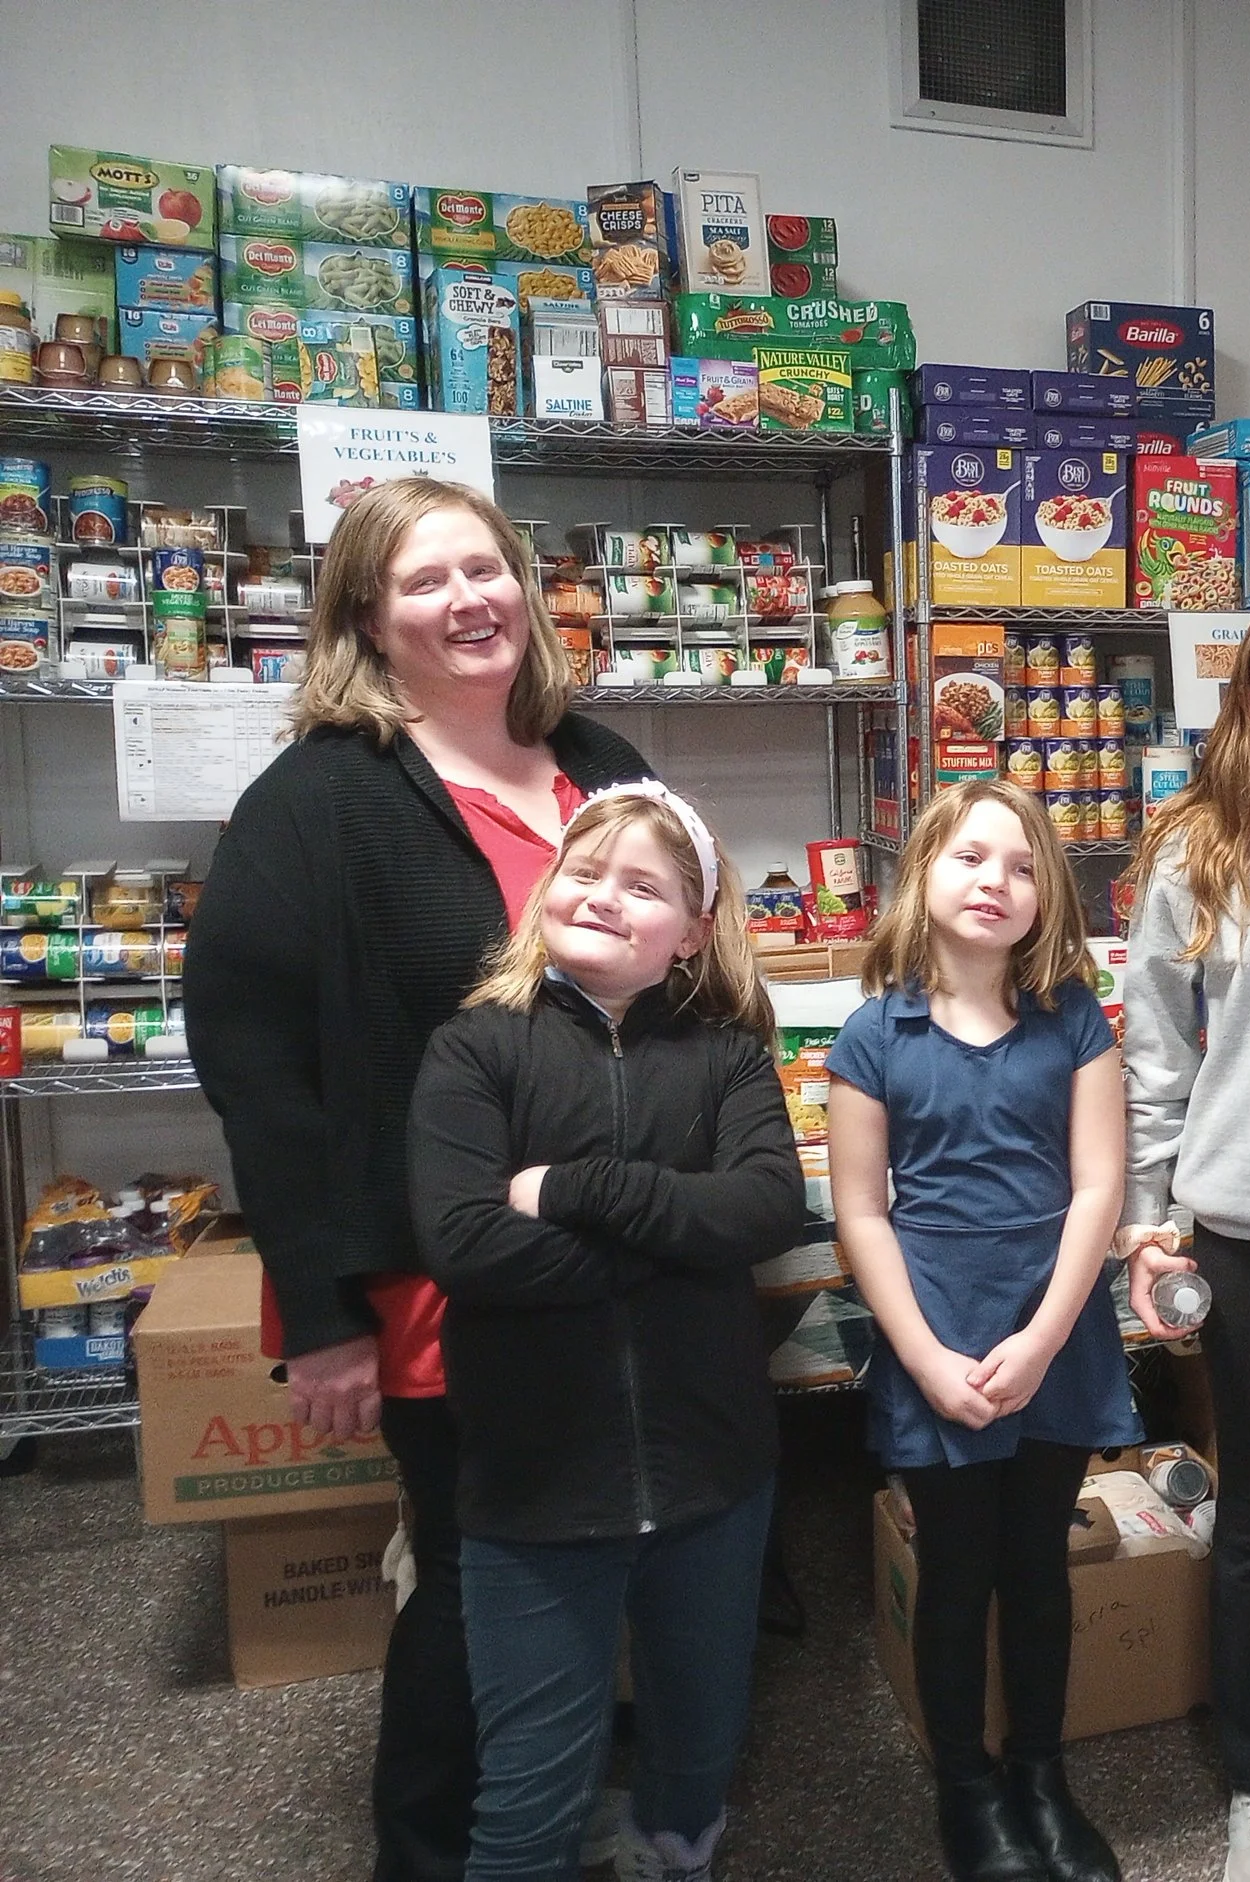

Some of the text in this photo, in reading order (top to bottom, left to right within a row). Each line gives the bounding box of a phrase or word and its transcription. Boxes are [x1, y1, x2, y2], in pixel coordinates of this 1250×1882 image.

[394, 188, 403, 200] 8
[441, 203, 483, 216] Del Monte
[701, 193, 747, 215] PITA
[578, 205, 588, 217] 8
[599, 210, 643, 221] CHEESE
[602, 220, 642, 231] CRISPS
[706, 217, 743, 225] CRACKERS
[823, 219, 834, 229] 12
[709, 226, 741, 236] SEA SALT
[248, 250, 294, 265] Del Monte
[396, 256, 407, 269] 8
[581, 270, 591, 283] 8
[824, 268, 835, 277] 12
[453, 286, 496, 301] SOFT &
[449, 300, 494, 315] CHEWY
[786, 300, 879, 324] CRUSHED
[789, 319, 829, 329] TOMATOES
[1198, 311, 1210, 330] 6
[400, 322, 410, 334] 8
[1126, 326, 1176, 344] Barilla
[760, 351, 847, 373] NATURE VALLEY
[779, 368, 831, 380] CRUNCHY
[403, 389, 413, 403] 8
[452, 391, 468, 404] 100
[545, 399, 593, 412] SALTINE
[351, 427, 438, 445] FRUIT'S &
[1137, 440, 1173, 455] arilla
[333, 445, 457, 466] VEGETABLE'S
[1166, 480, 1208, 496] FRUIT
[1148, 490, 1224, 517] ROUNDS
[934, 562, 1009, 574] OASTED OATS
[1035, 565, 1114, 577] TOASTED OATS
[1212, 629, 1246, 640] GRAI
[977, 640, 999, 656] pcs
[942, 756, 993, 768] STUFFING MIX
[1159, 773, 1180, 782] STEEL
[1153, 780, 1170, 790] CUT
[76, 1267, 130, 1297] Welch's
[199, 1468, 316, 1496] PRODUCE
[283, 1555, 350, 1580] BAKED
[264, 1581, 345, 1609] HANDLE
